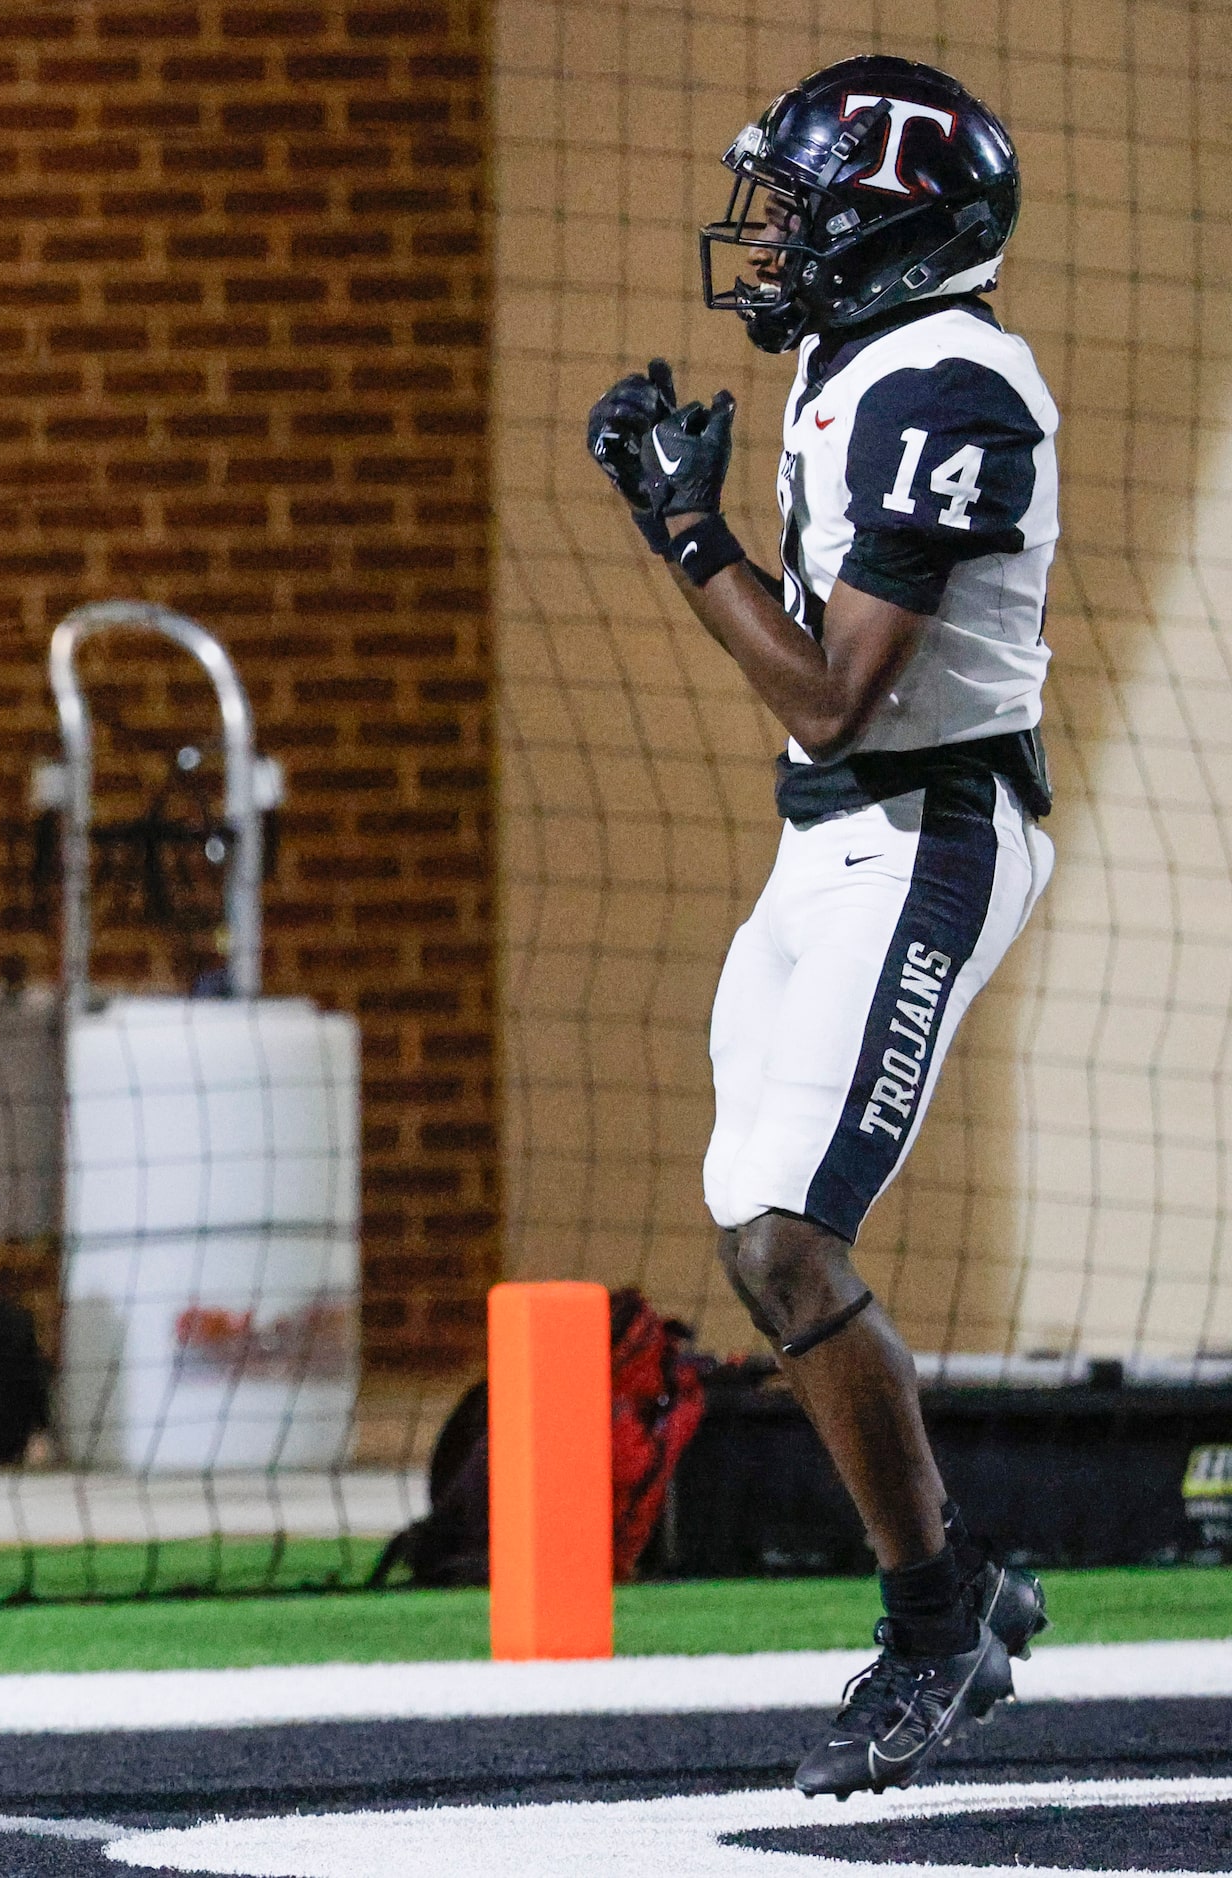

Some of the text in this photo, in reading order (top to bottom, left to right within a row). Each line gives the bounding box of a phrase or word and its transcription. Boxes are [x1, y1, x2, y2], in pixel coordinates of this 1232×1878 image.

[839, 92, 957, 198] T
[883, 427, 984, 530] 14
[859, 940, 952, 1142] TROJANS
